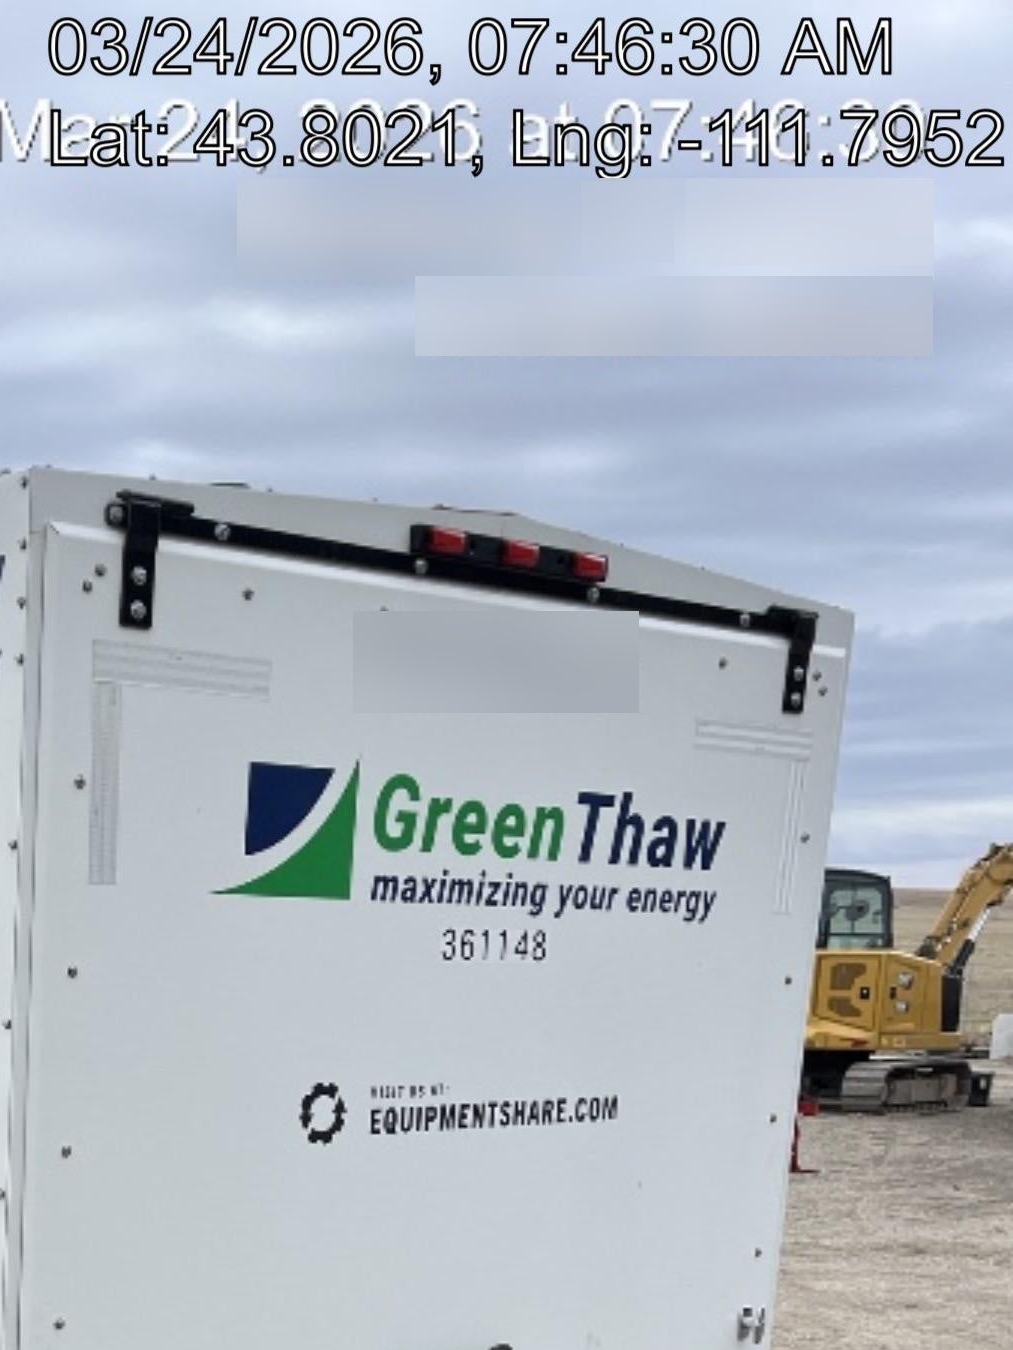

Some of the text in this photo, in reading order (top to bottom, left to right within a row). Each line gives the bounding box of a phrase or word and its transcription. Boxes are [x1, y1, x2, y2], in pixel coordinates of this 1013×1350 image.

[369, 869, 718, 924] maximizing your energy
[441, 928, 548, 962] 361148
[369, 1095, 620, 1136] EQUIPMENTSHARE.COM
